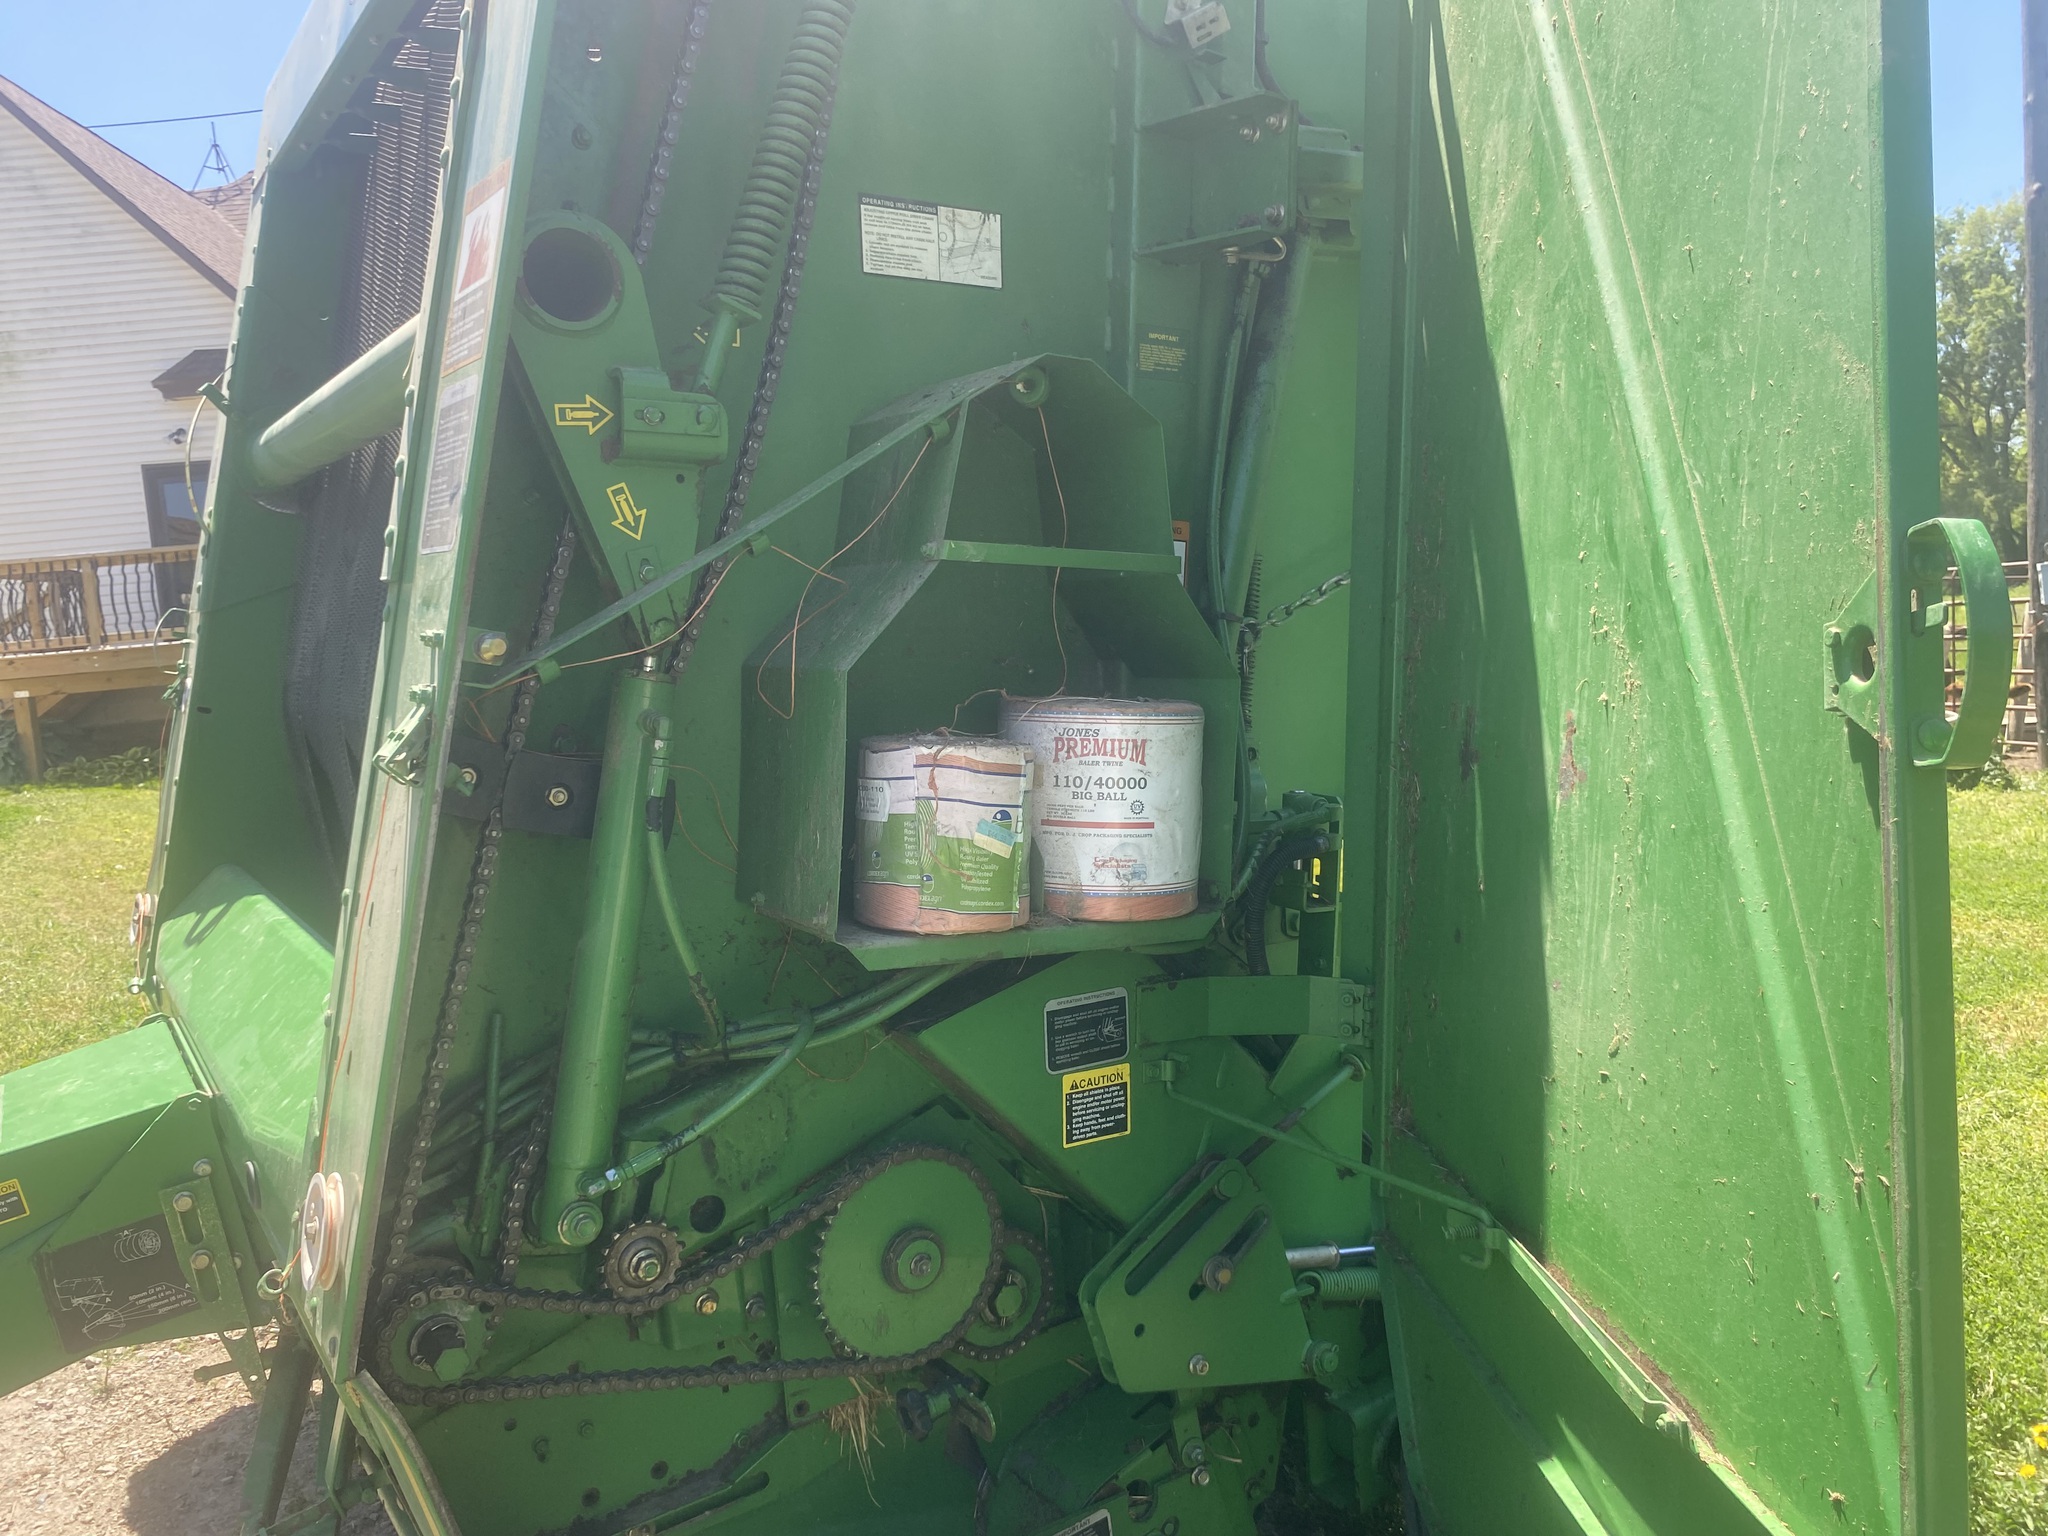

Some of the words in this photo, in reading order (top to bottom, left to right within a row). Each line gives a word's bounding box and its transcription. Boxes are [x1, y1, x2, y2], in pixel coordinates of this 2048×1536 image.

[862, 198, 895, 208] OPERATING
[896, 202, 937, 214] INSRUCTIONS
[1149, 333, 1179, 342] IMPORTANT
[1172, 527, 1182, 535] NG
[1059, 728, 1100, 738] JONES
[1053, 737, 1147, 767] PREMIUM
[1053, 775, 1148, 791] 110/40000
[1072, 791, 1093, 800] BIG
[1097, 792, 1128, 801] BALL
[981, 863, 999, 871] Quality
[1057, 998, 1083, 1006] OPERATING
[1084, 991, 1116, 1001] INSTRUCTIONS
[1080, 1072, 1124, 1089] CAUTION
[1073, 1097, 1094, 1105] Disengage
[1087, 1106, 1105, 1114] servicing
[0, 1184, 16, 1194] ON
[135, 1295, 157, 1305] 100mm
[147, 1299, 169, 1309] 150mm
[158, 1303, 180, 1314] 200mm
